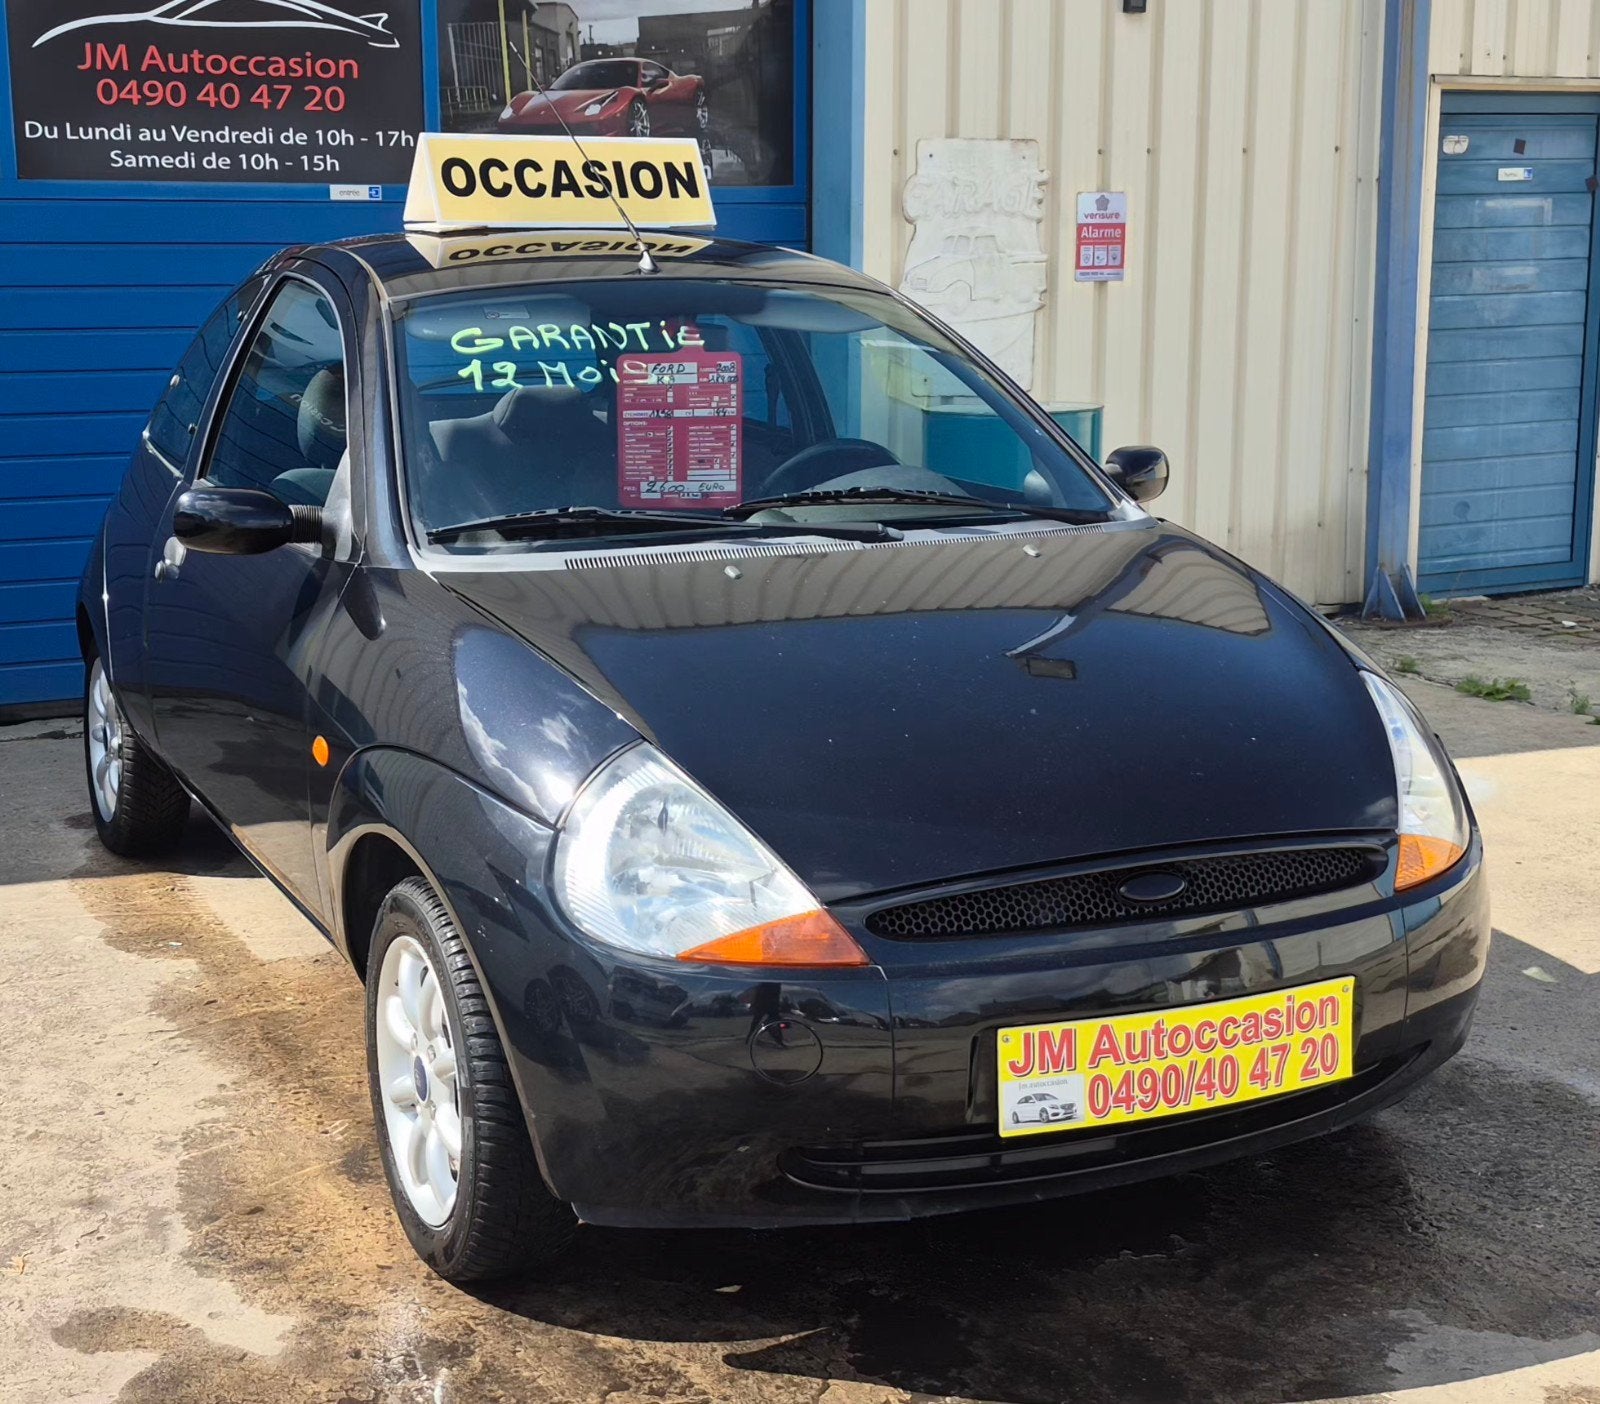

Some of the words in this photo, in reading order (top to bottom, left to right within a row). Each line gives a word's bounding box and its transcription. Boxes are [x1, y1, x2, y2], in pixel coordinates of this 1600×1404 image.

[77, 42, 129, 72] JM
[140, 44, 359, 80] Autoccasion
[96, 78, 187, 108] 0490
[196, 82, 241, 109] 40
[250, 84, 293, 111] 47
[303, 85, 346, 112] 20
[24, 120, 59, 140] Du
[65, 121, 132, 142] Lundi
[138, 128, 167, 143] au
[171, 123, 274, 146] Vendredi
[279, 126, 308, 146] de
[316, 129, 354, 147] 10h
[374, 130, 414, 148] 17h
[109, 150, 197, 170] Samedi
[201, 151, 232, 171] de
[237, 152, 280, 171] 10h
[299, 154, 341, 172] 15h
[440, 157, 701, 200] OCCASION
[1080, 225, 1122, 239] Alarme
[1083, 211, 1121, 220] verisure
[457, 358, 525, 392] 12
[1007, 1027, 1077, 1078] JM
[1087, 994, 1340, 1069] Autoccasion
[1087, 1053, 1241, 1119] 0490/40
[1249, 1042, 1292, 1091] 47
[1300, 1032, 1339, 1082] 20
